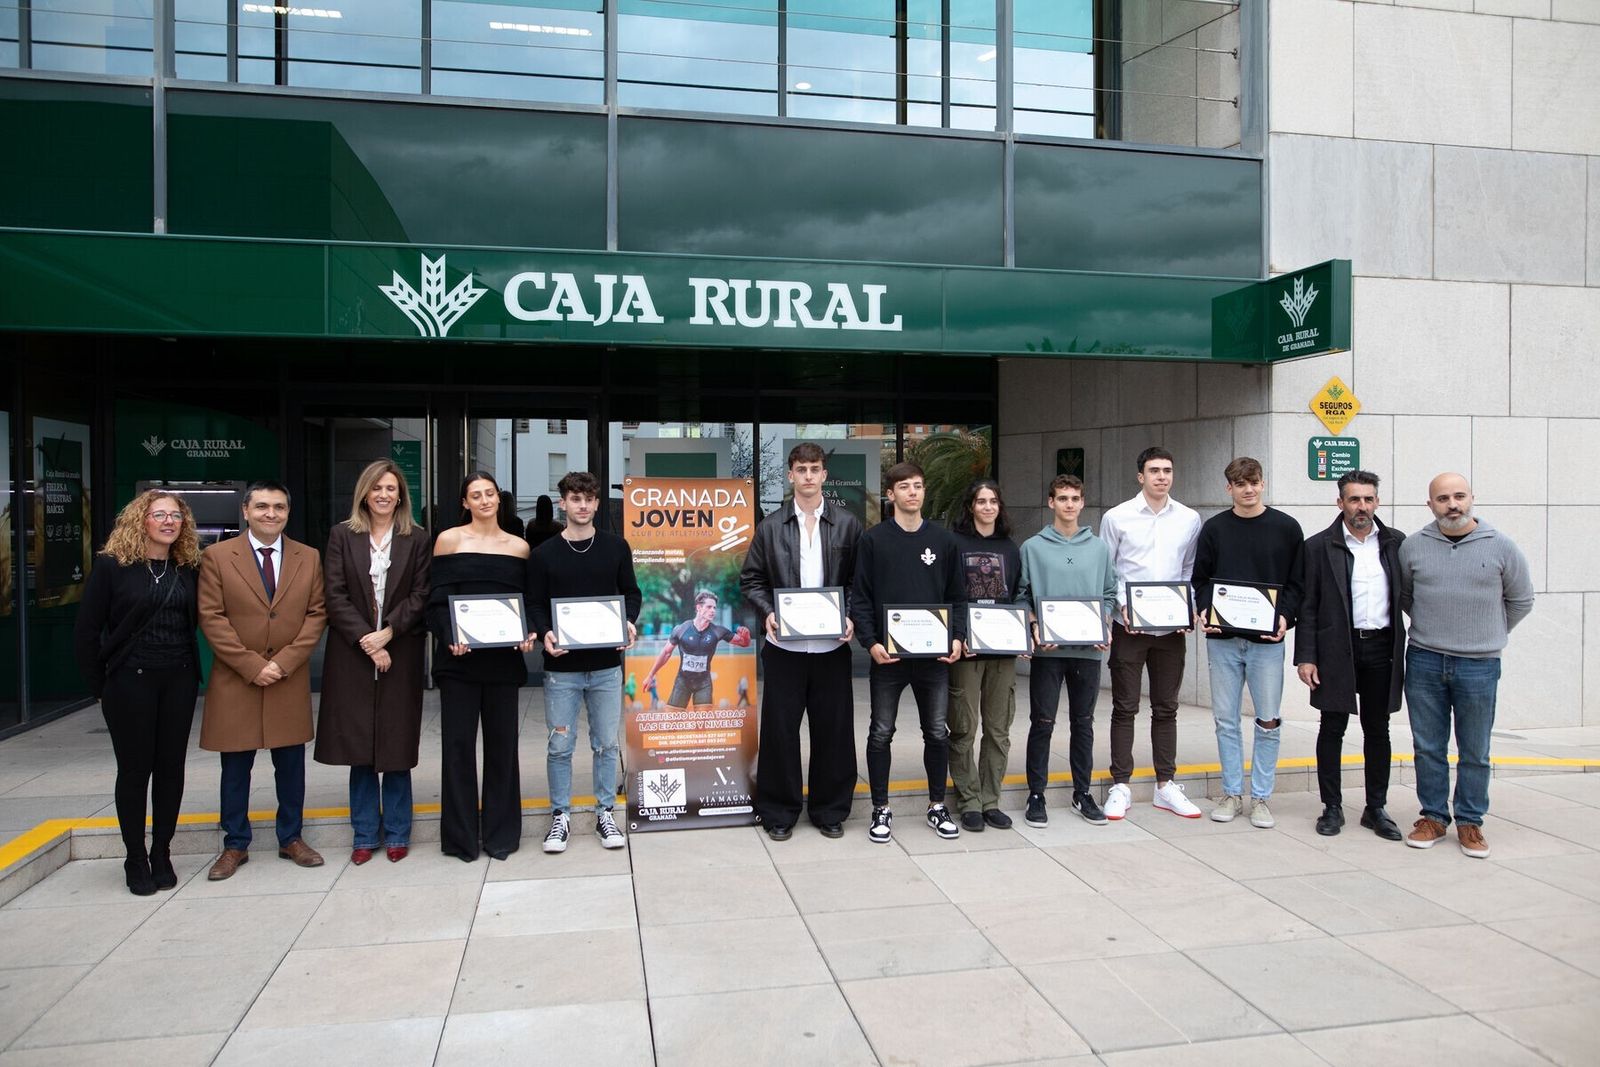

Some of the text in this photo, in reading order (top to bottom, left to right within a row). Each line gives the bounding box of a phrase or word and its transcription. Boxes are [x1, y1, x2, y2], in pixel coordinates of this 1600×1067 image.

[503, 271, 902, 332] CAJA RURAL
[1278, 328, 1320, 344] CAJA RURAL
[1290, 340, 1315, 350] GRANADA
[1320, 402, 1353, 410] SEGUROS
[171, 440, 246, 450] CAJA RURAL
[630, 488, 748, 508] GRANADA
[632, 510, 714, 528] JOVEN
[636, 710, 746, 722] ATLETISMO PARA TODAS
[639, 719, 744, 731] LAS EDADES Y NIVELES
[639, 806, 687, 816] CAJA RURAL
